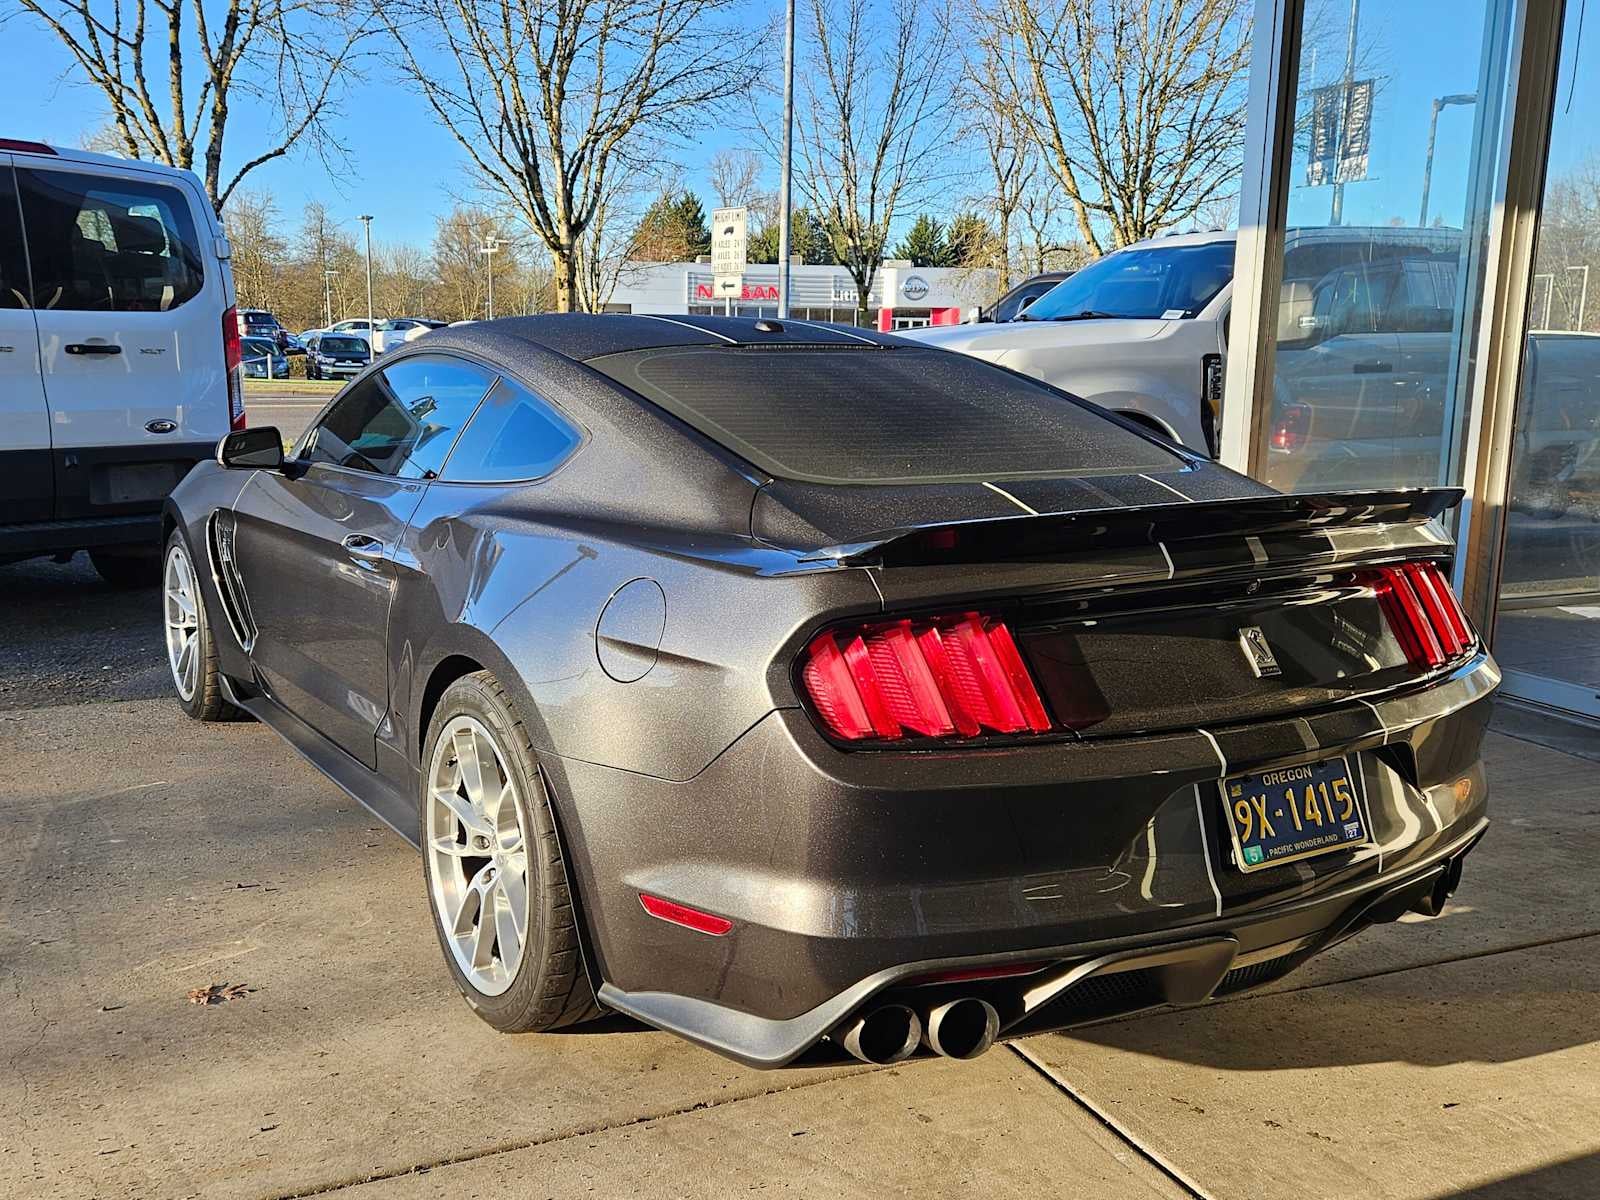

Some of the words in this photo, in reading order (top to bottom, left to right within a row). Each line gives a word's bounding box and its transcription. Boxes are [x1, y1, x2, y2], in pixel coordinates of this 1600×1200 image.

[1262, 766, 1313, 787] OREGON
[1250, 847, 1259, 862] 5
[1268, 845, 1294, 859] PACIFIC
[1294, 833, 1338, 851] WONDERLAND
